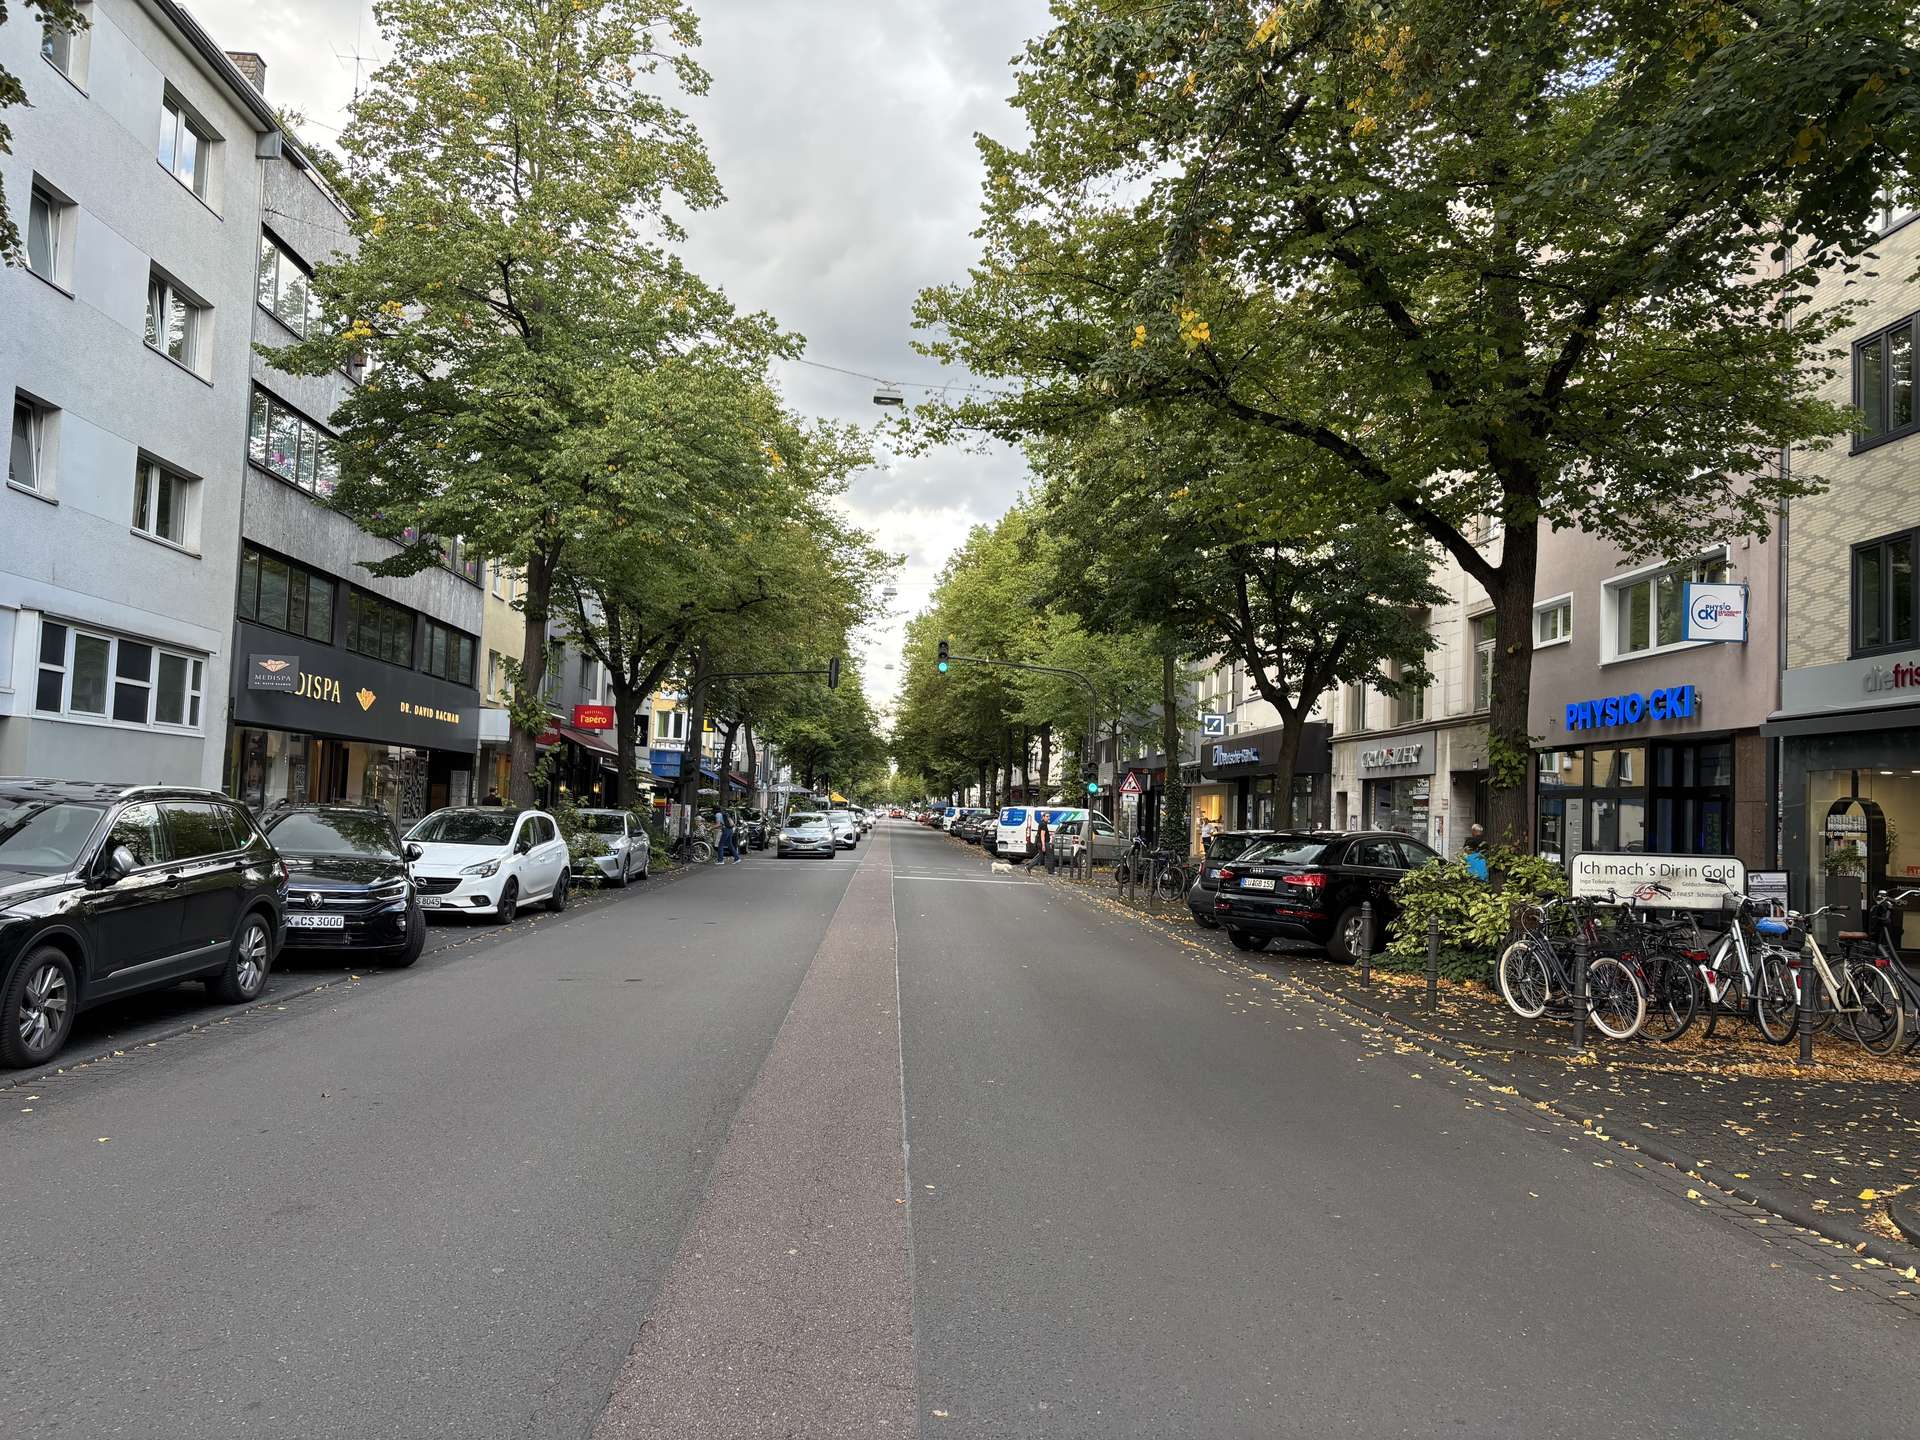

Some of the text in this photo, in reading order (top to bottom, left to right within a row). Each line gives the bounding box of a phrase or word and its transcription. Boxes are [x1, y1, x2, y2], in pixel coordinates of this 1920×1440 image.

[254, 674, 292, 682] MEDISPA
[400, 701, 412, 714] DR.
[414, 704, 434, 719] DAVID
[1565, 684, 1697, 733] PHYSIO CKI
[1580, 861, 1600, 875] Ich
[1660, 863, 1681, 877] Dir
[1685, 864, 1698, 878] in
[1701, 864, 1736, 879] Gold
[300, 916, 315, 927] CS
[316, 916, 343, 927] 3000
